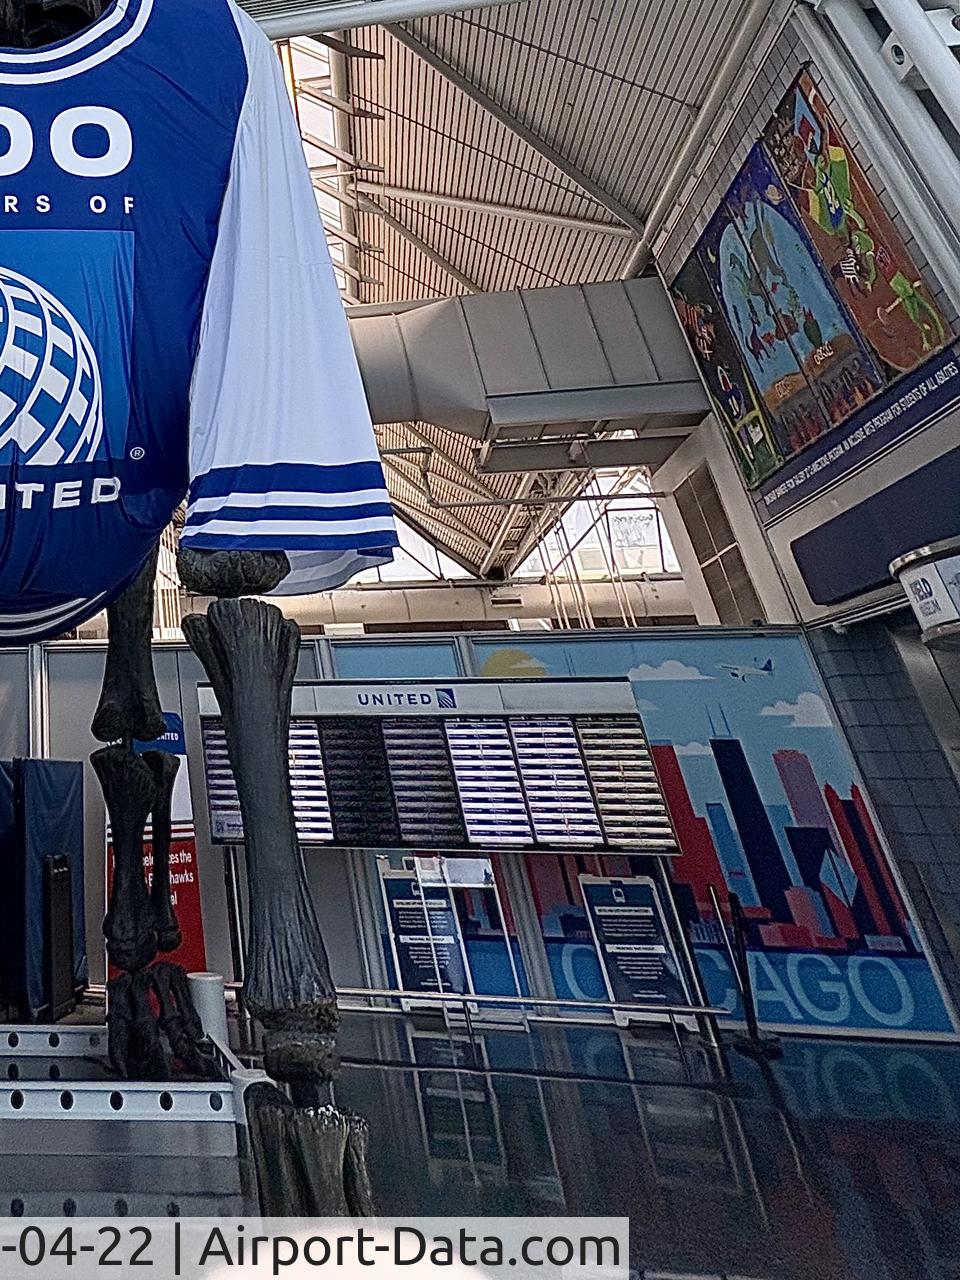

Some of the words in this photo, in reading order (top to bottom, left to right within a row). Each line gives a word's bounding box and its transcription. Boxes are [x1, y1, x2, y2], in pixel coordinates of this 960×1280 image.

[89, 196, 135, 214] OF
[357, 693, 432, 706] UNITED
[180, 849, 192, 864] the
[561, 943, 915, 1027] CCAGO
